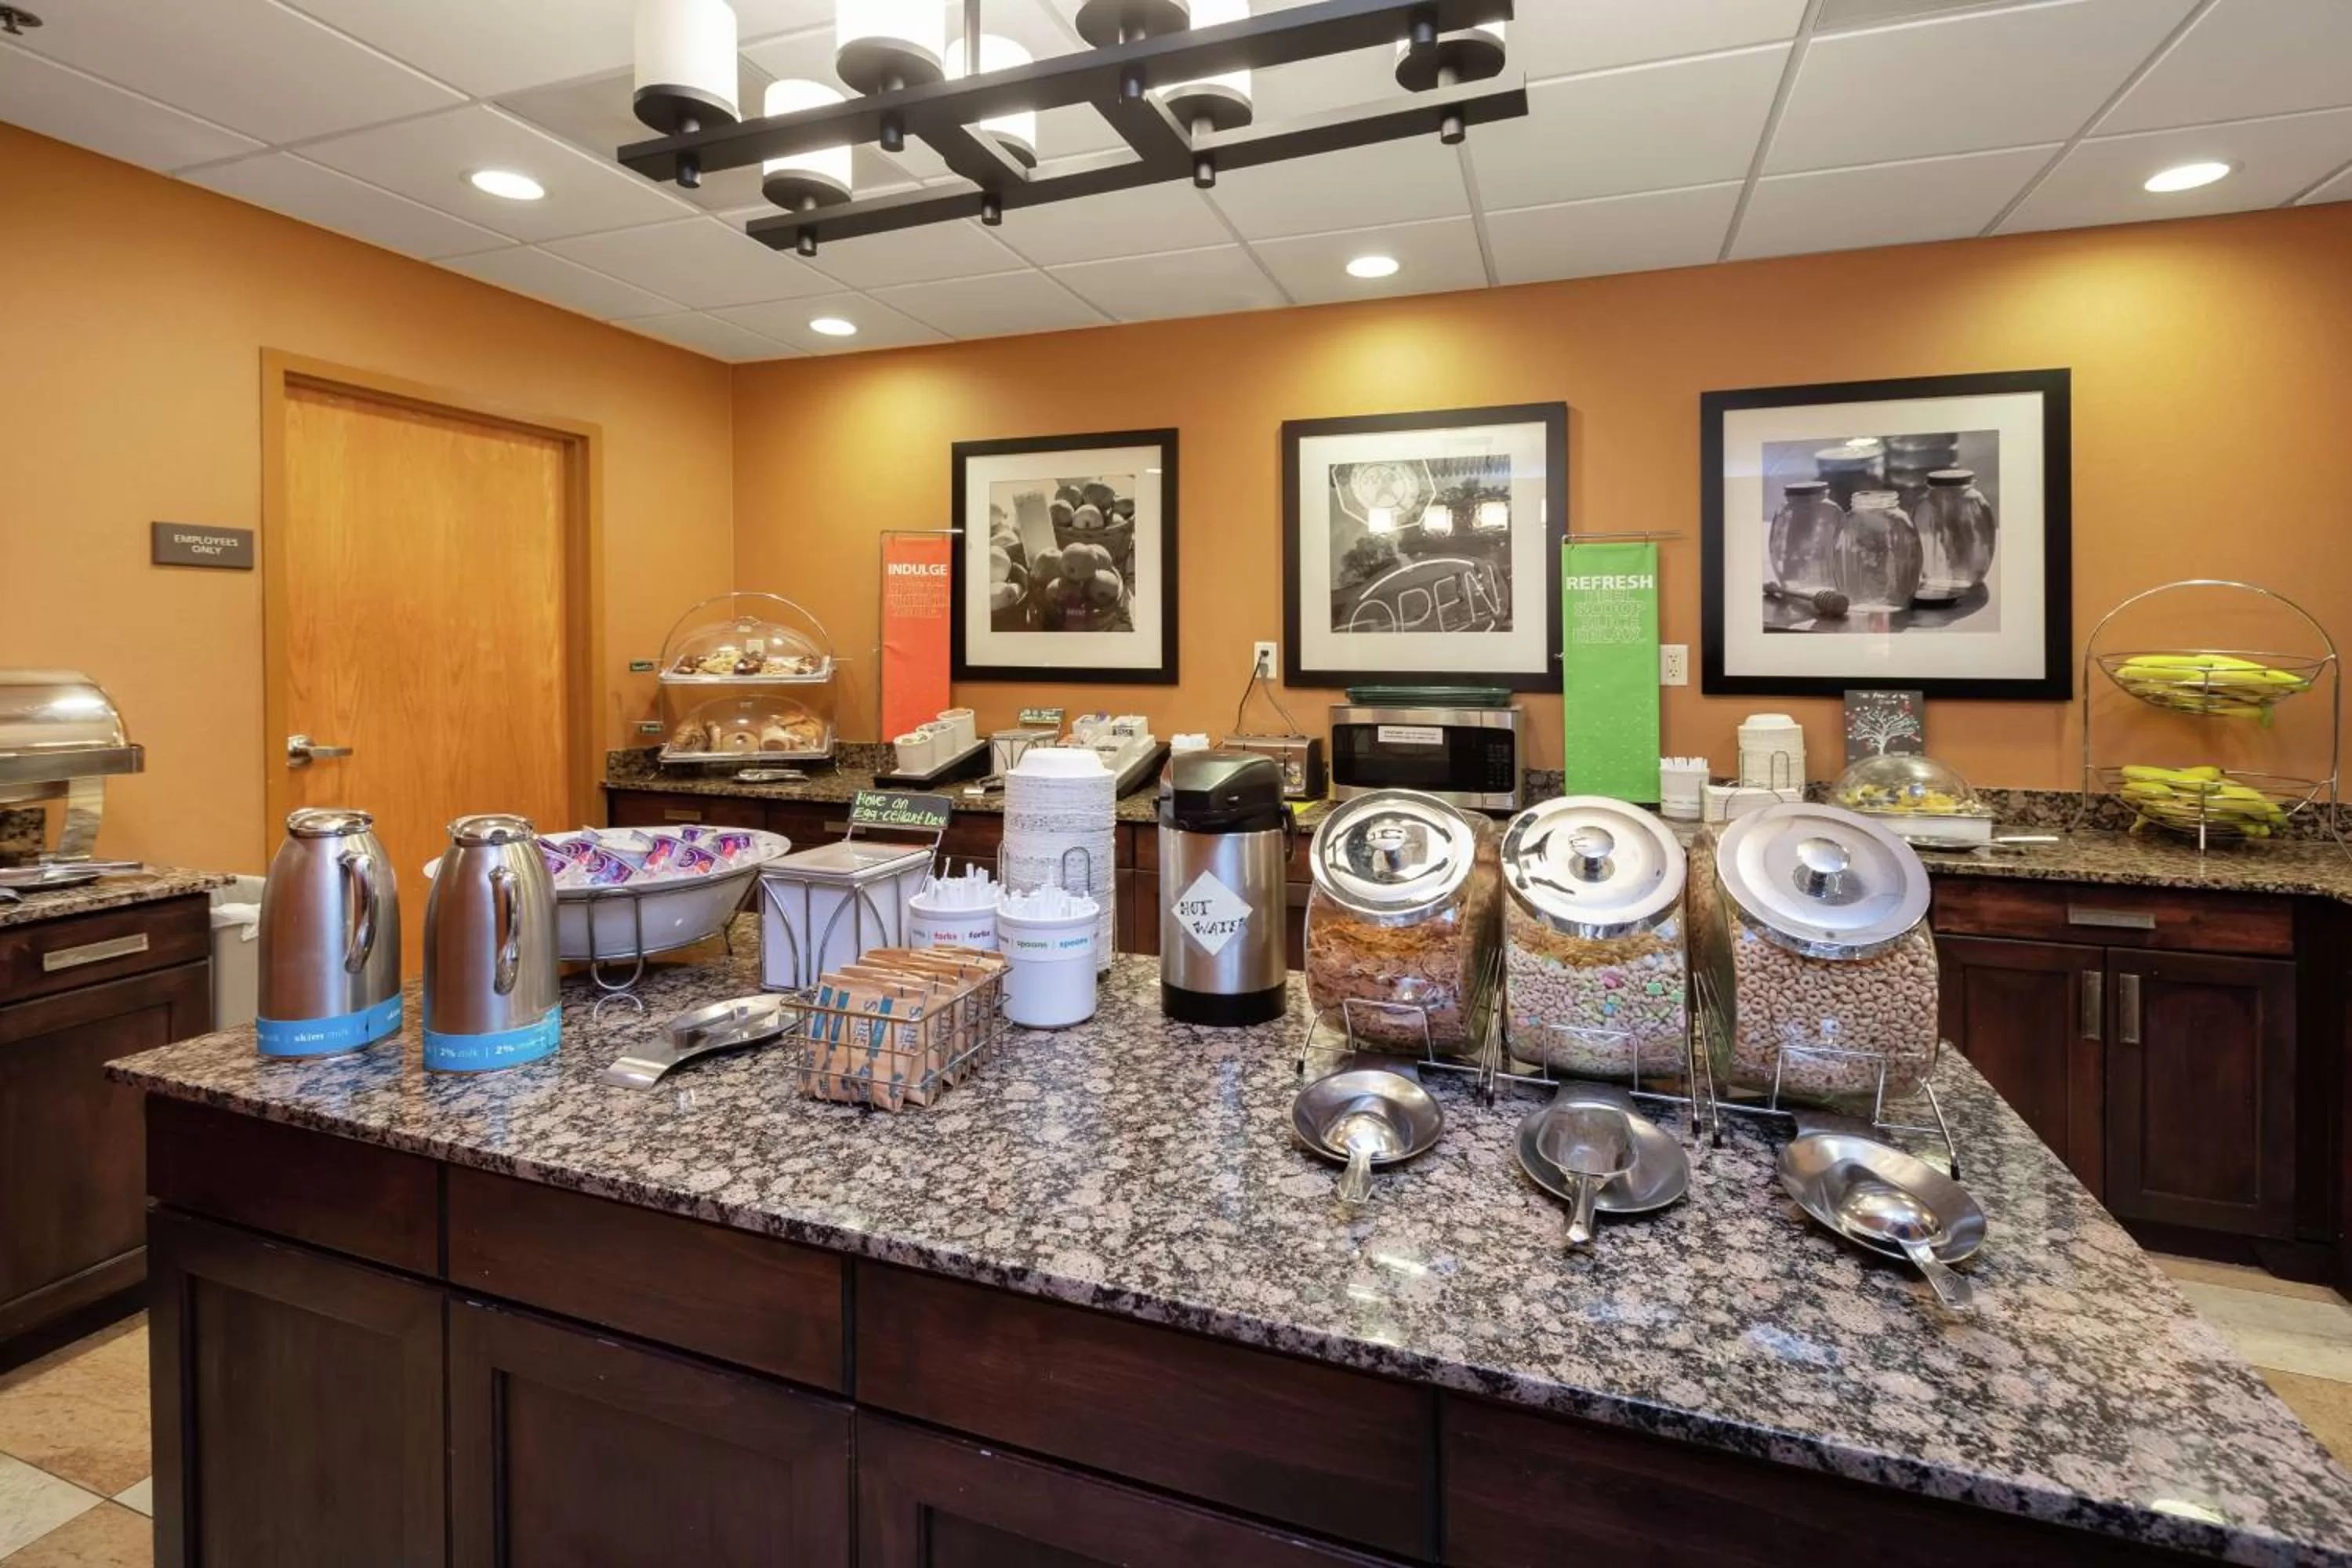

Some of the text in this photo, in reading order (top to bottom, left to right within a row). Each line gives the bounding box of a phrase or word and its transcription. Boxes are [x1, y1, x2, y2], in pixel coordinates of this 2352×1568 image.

[174, 534, 238, 547] EMPLOYEES
[191, 545, 222, 555] ONLY
[887, 563, 948, 575] INDULGE
[1566, 575, 1653, 590] REFRESH
[1180, 899, 1213, 916] HOT
[294, 1033, 325, 1042] skim
